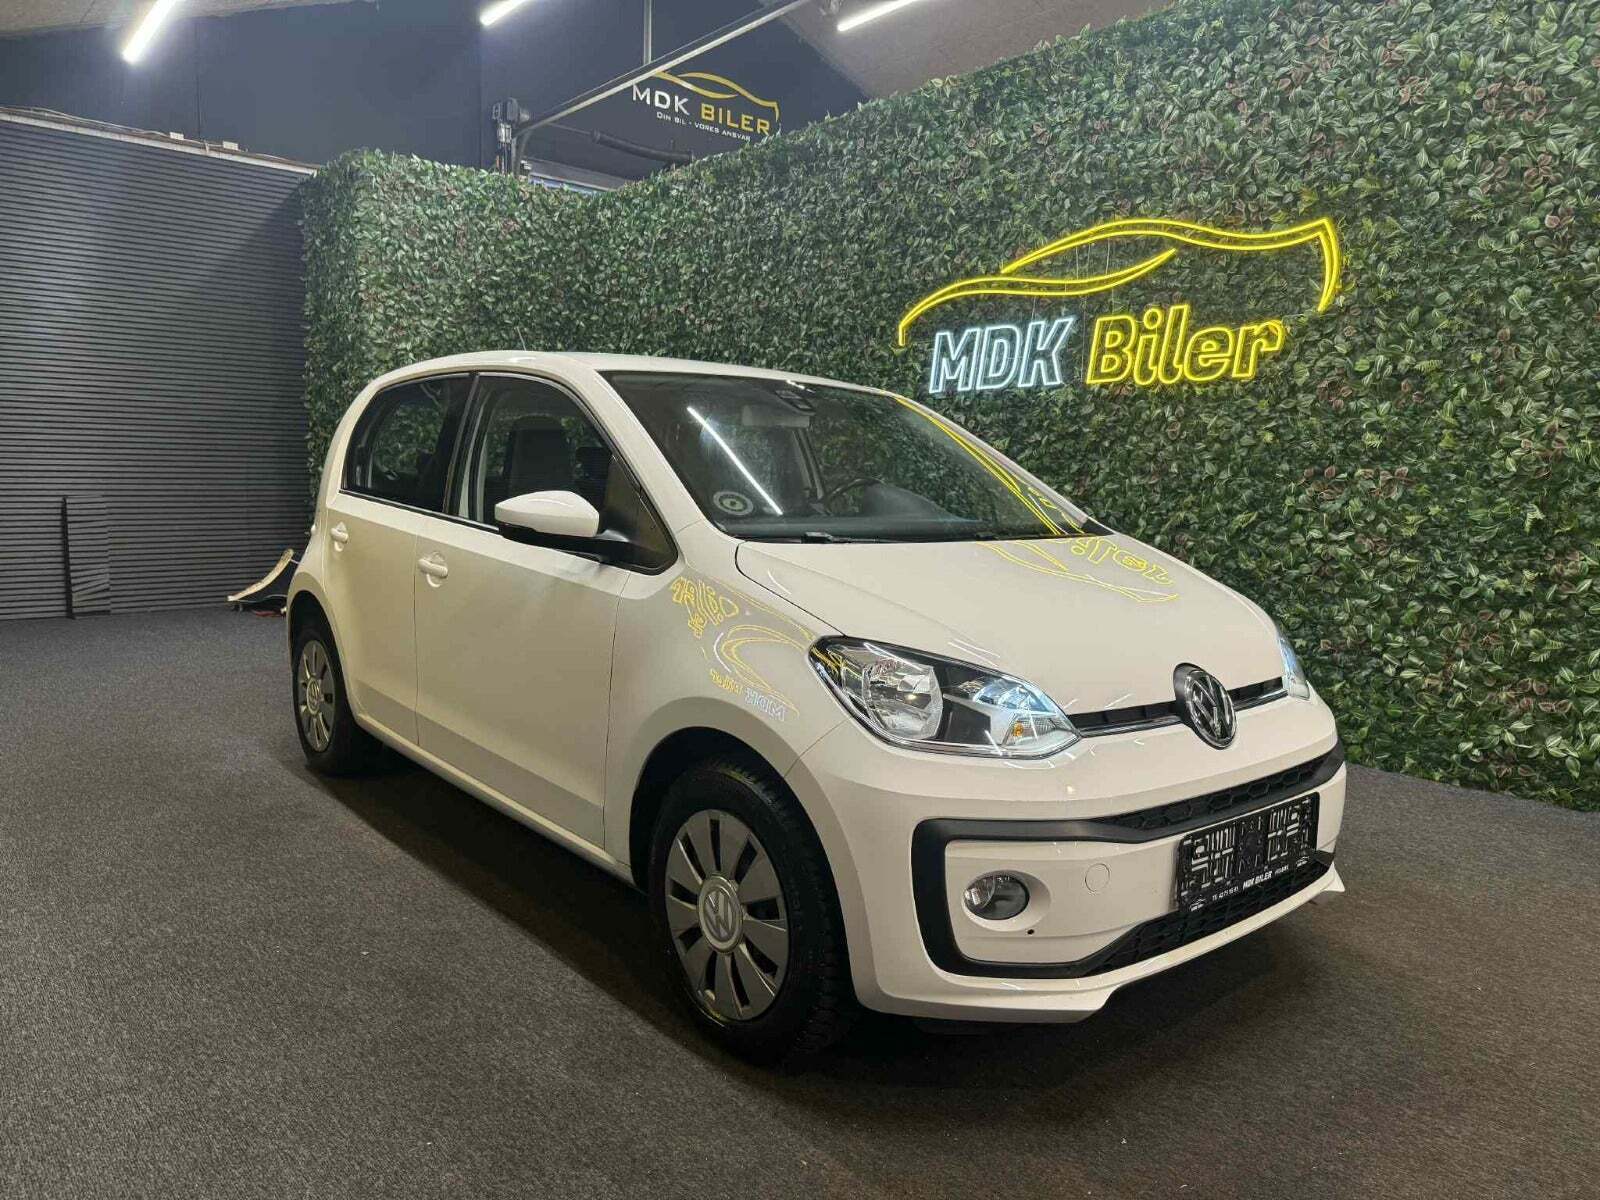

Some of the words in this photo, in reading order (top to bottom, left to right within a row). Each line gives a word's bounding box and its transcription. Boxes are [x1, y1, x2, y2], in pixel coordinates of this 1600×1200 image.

[632, 84, 690, 116] MDK
[701, 102, 770, 136] BILER
[929, 315, 1077, 395] MDK
[1087, 304, 1285, 387] Biler
